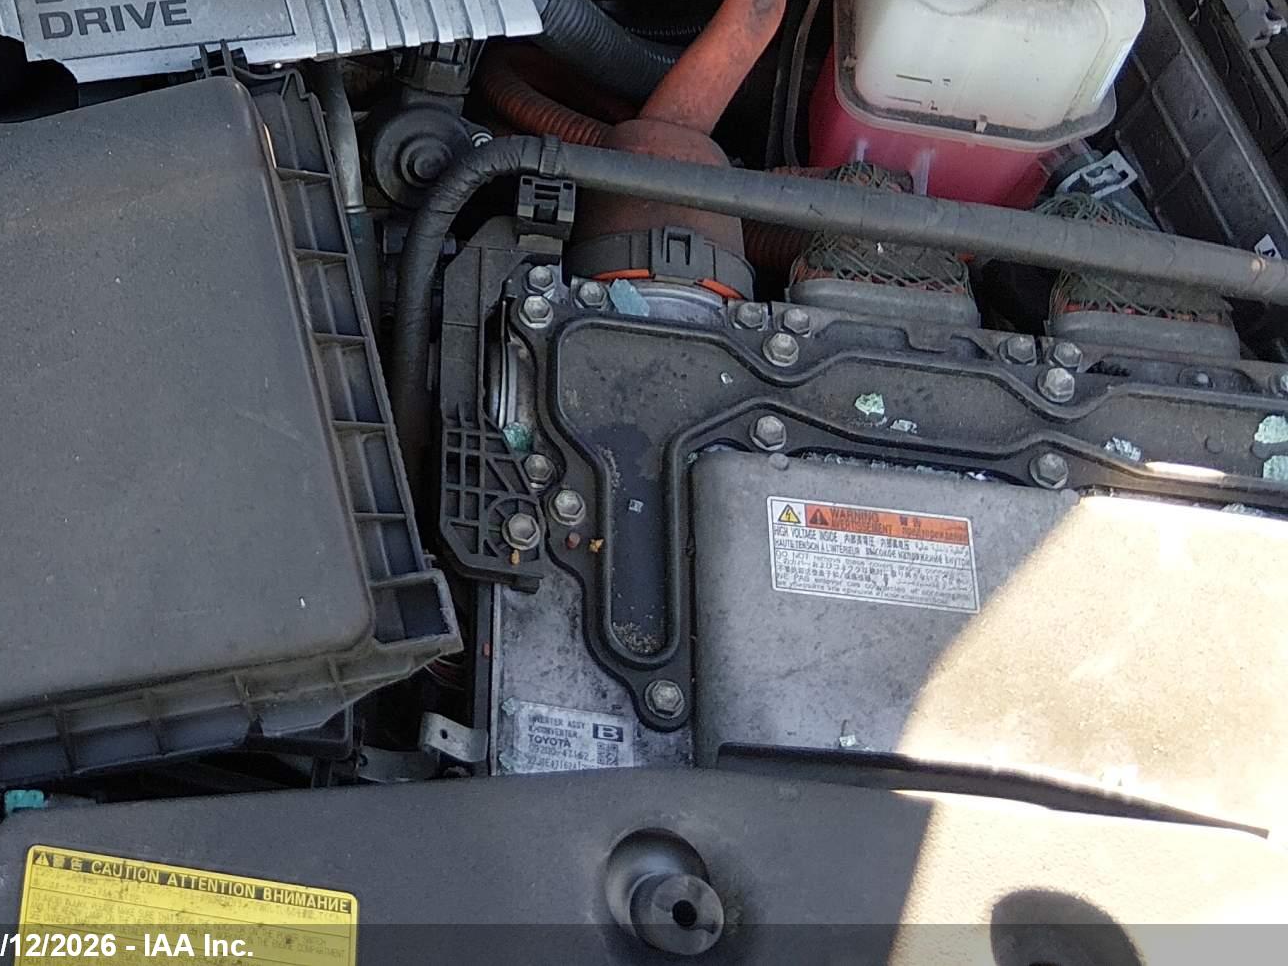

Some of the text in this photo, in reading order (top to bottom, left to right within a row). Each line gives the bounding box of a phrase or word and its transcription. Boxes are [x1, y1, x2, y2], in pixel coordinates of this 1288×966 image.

[598, 725, 620, 740] B
[528, 734, 572, 748] TOYOTA
[91, 860, 160, 884] CAUTION
[167, 874, 256, 899] ATTENTION
[263, 887, 350, 913] ВНИМАНИЕ
